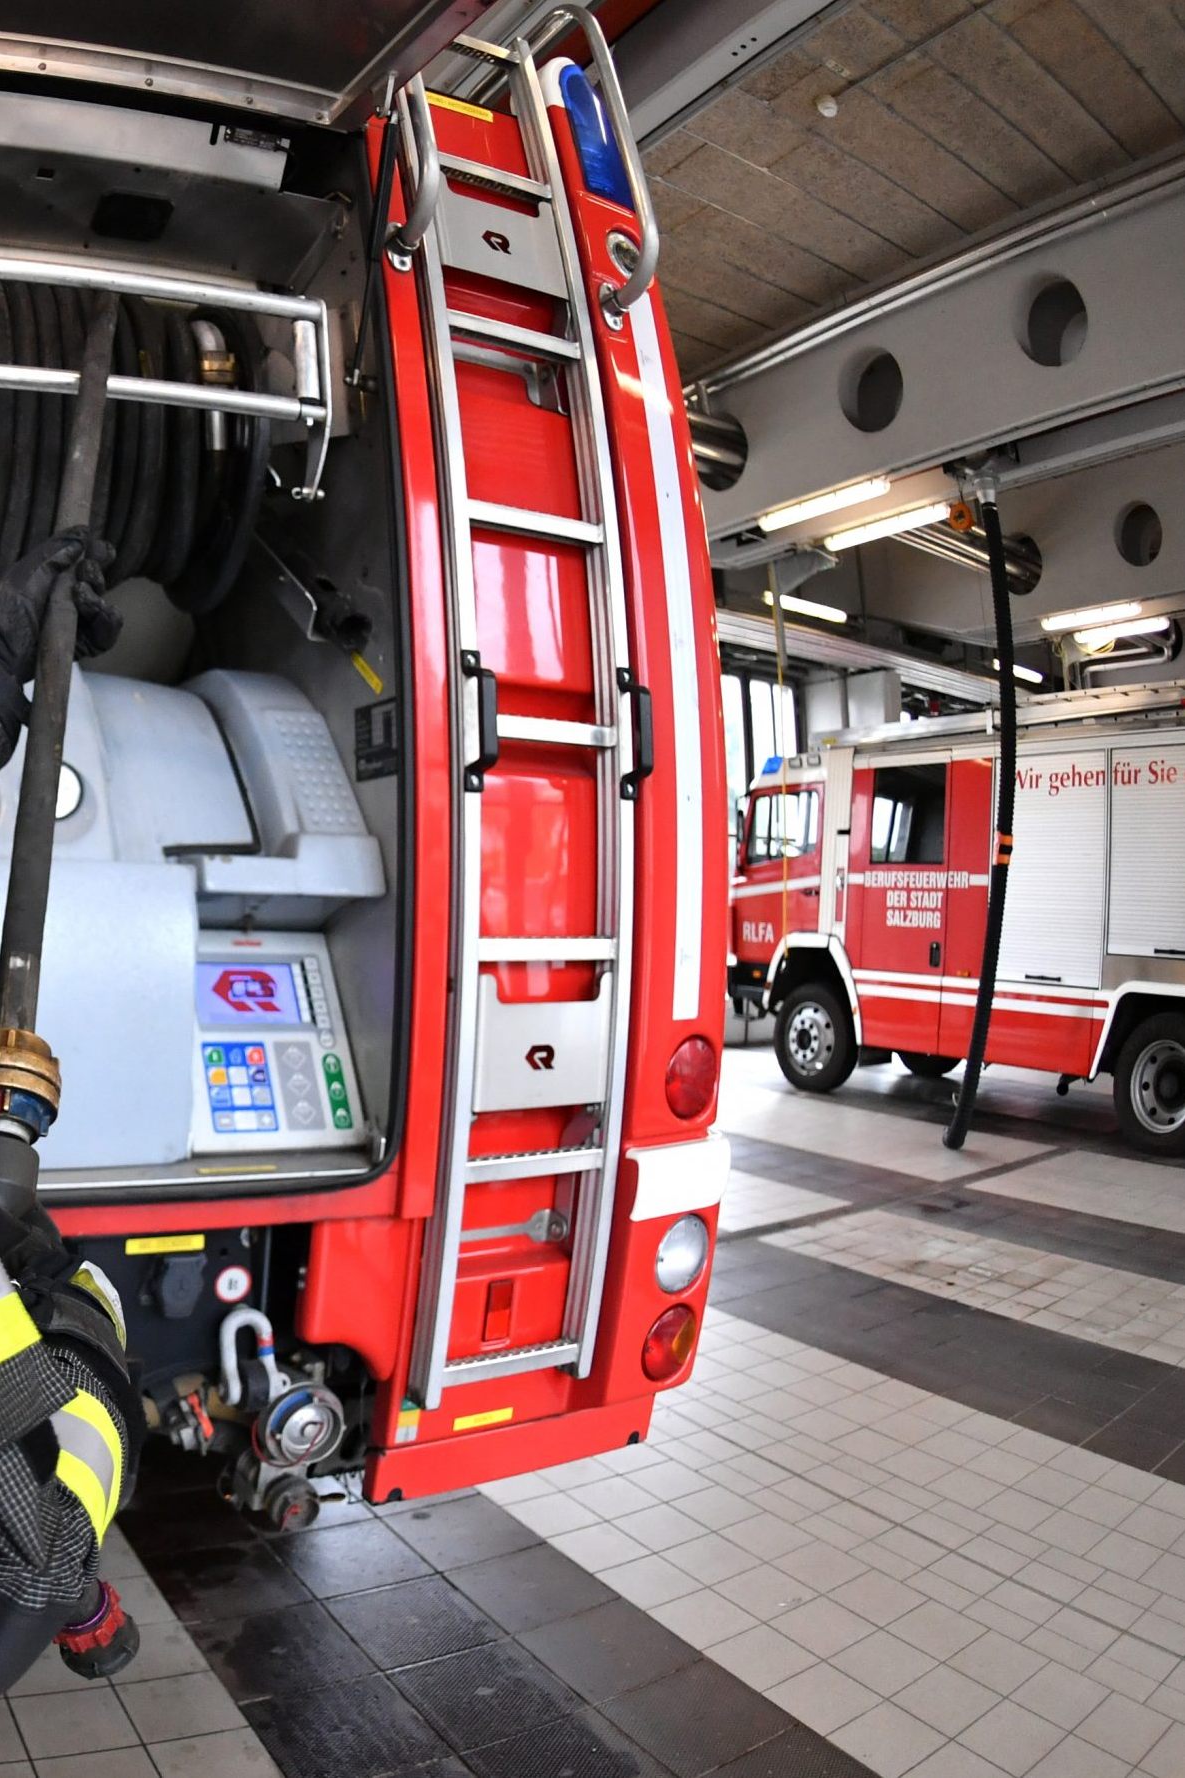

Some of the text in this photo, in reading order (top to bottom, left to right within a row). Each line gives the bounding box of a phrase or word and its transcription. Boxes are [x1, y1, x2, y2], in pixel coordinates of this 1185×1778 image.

[1048, 764, 1105, 796] gehen
[1113, 762, 1141, 787] für
[1148, 760, 1178, 785] Sie
[864, 870, 969, 889] BERUFSFEUERWEHR
[886, 891, 943, 909] DER STADT
[886, 910, 941, 928] SALZBURG
[743, 921, 774, 943] RLFA
